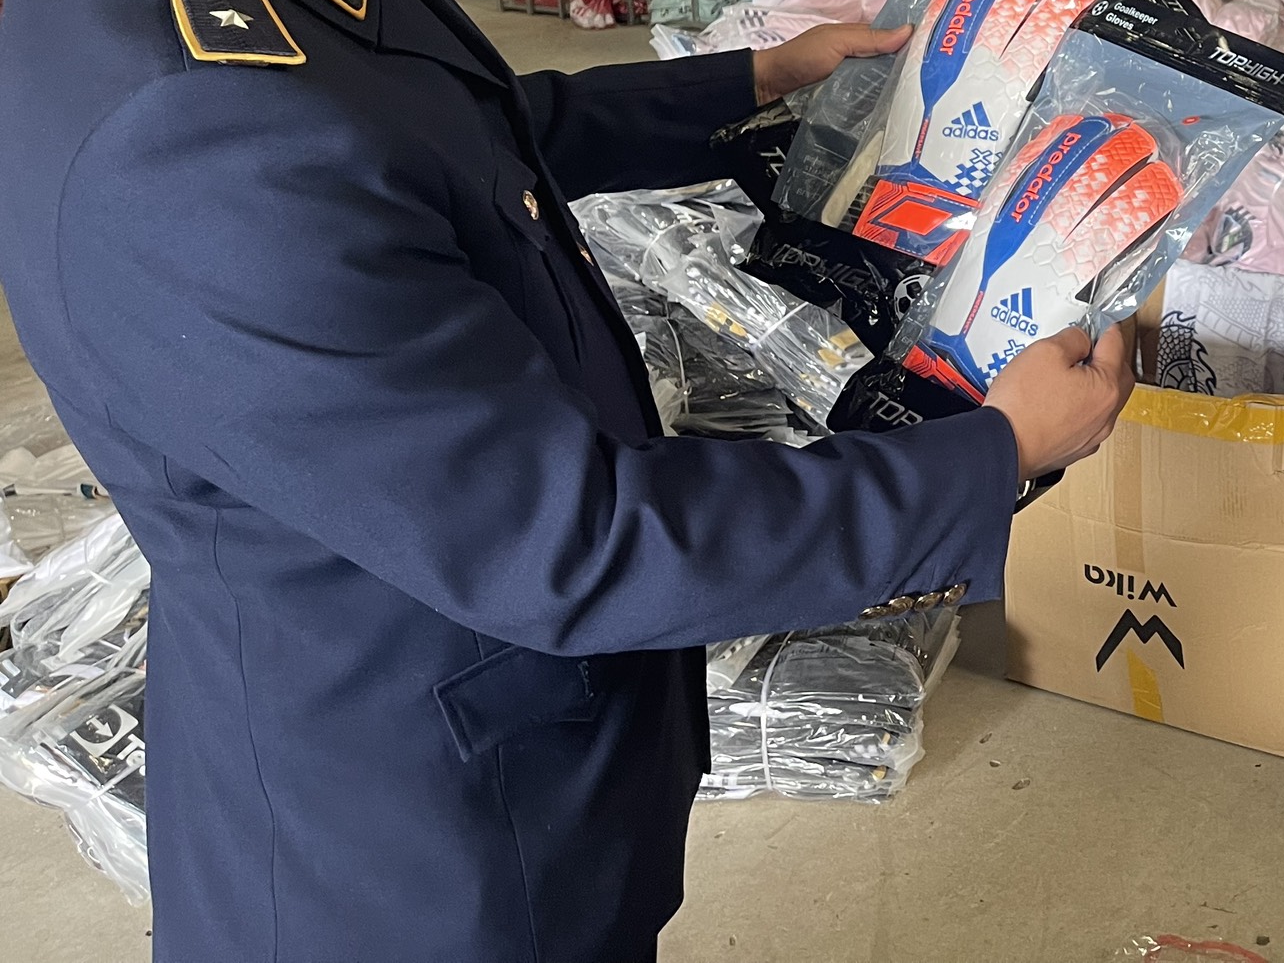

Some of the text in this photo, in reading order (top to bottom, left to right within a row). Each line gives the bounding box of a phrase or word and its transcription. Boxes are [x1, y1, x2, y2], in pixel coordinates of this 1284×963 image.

[1105, 11, 1135, 31] Gloves
[1113, 2, 1158, 25] Goalkeeper
[942, 125, 999, 142] adidas
[1010, 132, 1082, 223] predator
[990, 304, 1039, 336] adidas
